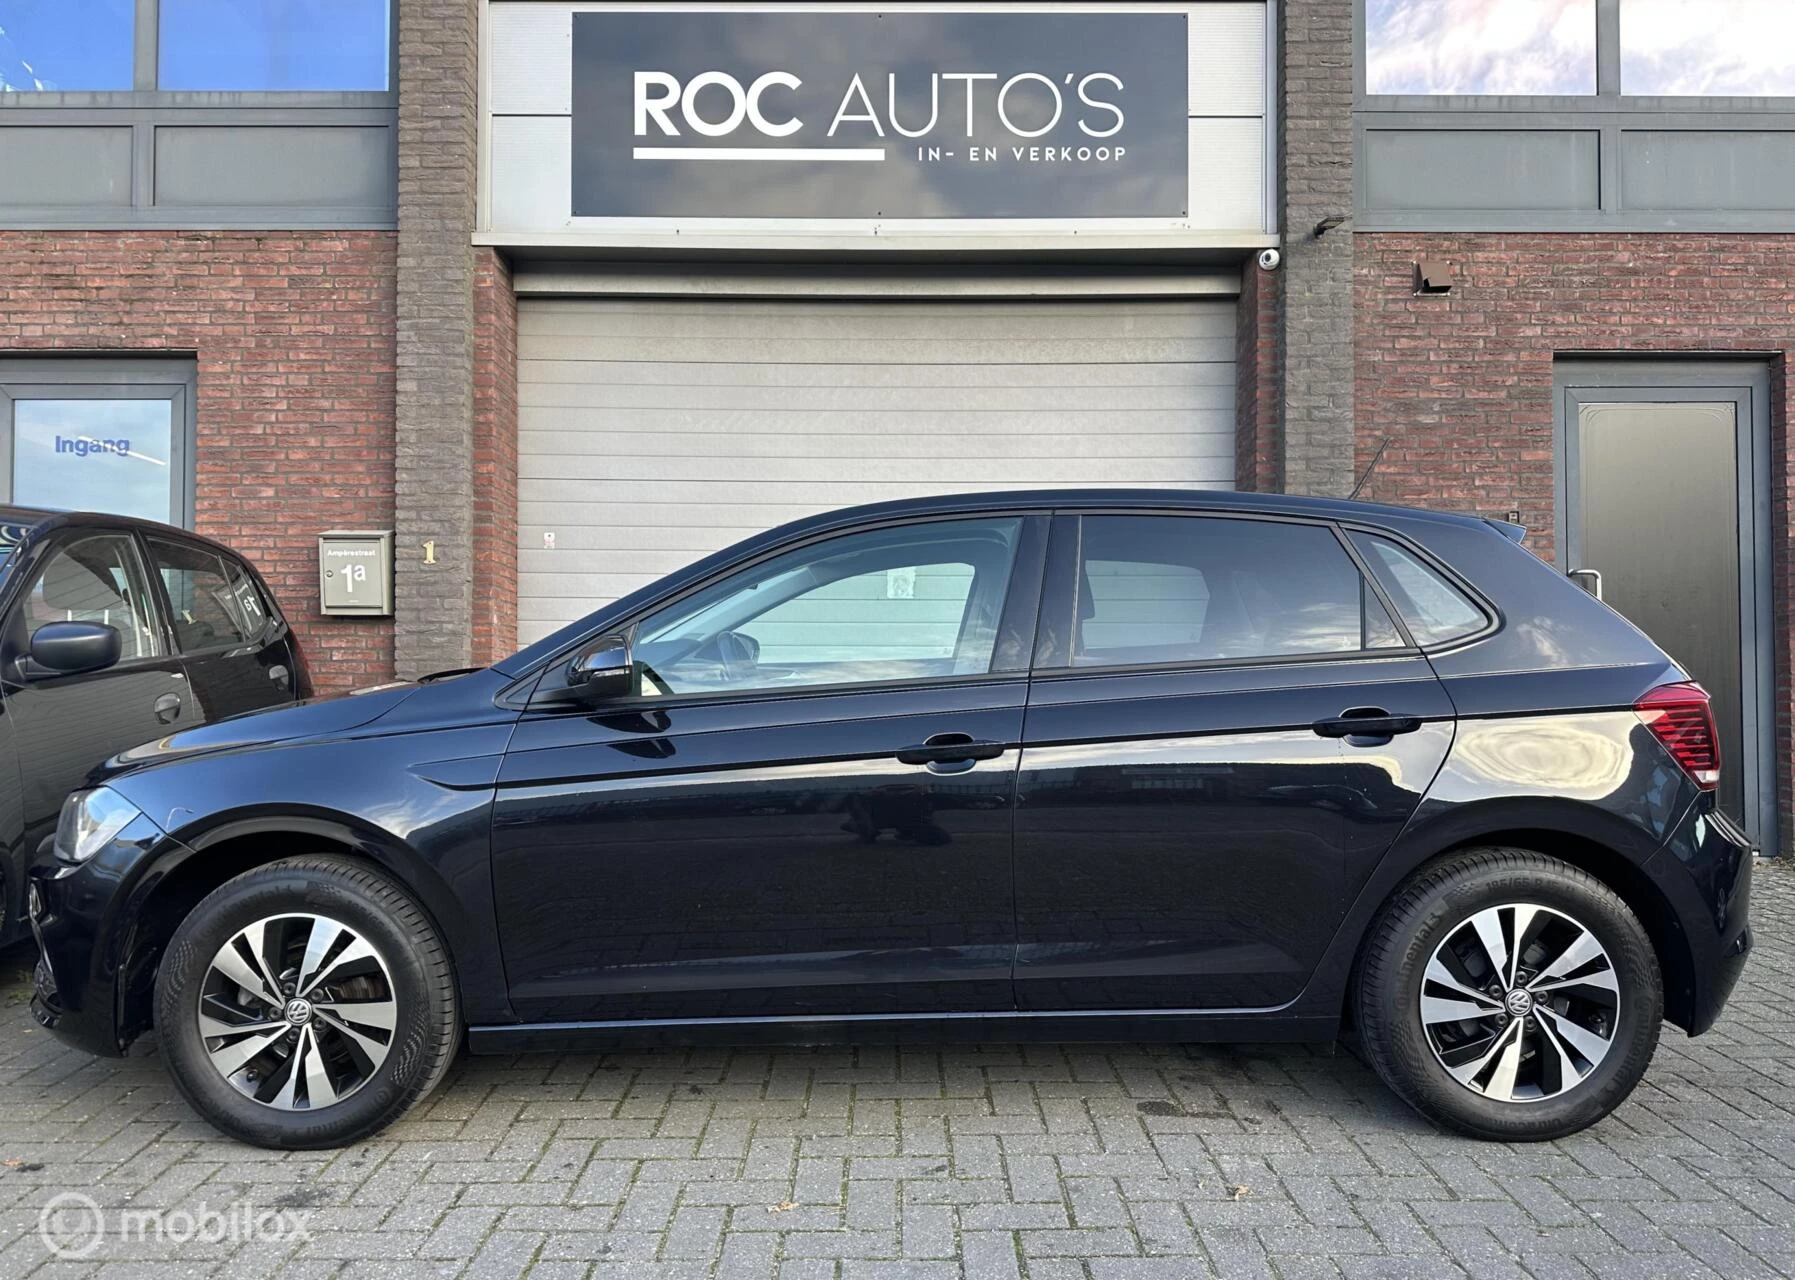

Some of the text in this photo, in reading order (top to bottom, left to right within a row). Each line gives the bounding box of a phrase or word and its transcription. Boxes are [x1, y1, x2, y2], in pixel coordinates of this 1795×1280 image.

[634, 71, 1124, 138] ROC AUTO'S
[918, 146, 1126, 161] IN- EN VERKOOP
[55, 435, 130, 457] Ingang
[422, 540, 437, 565] 1
[340, 564, 366, 593] 1a
